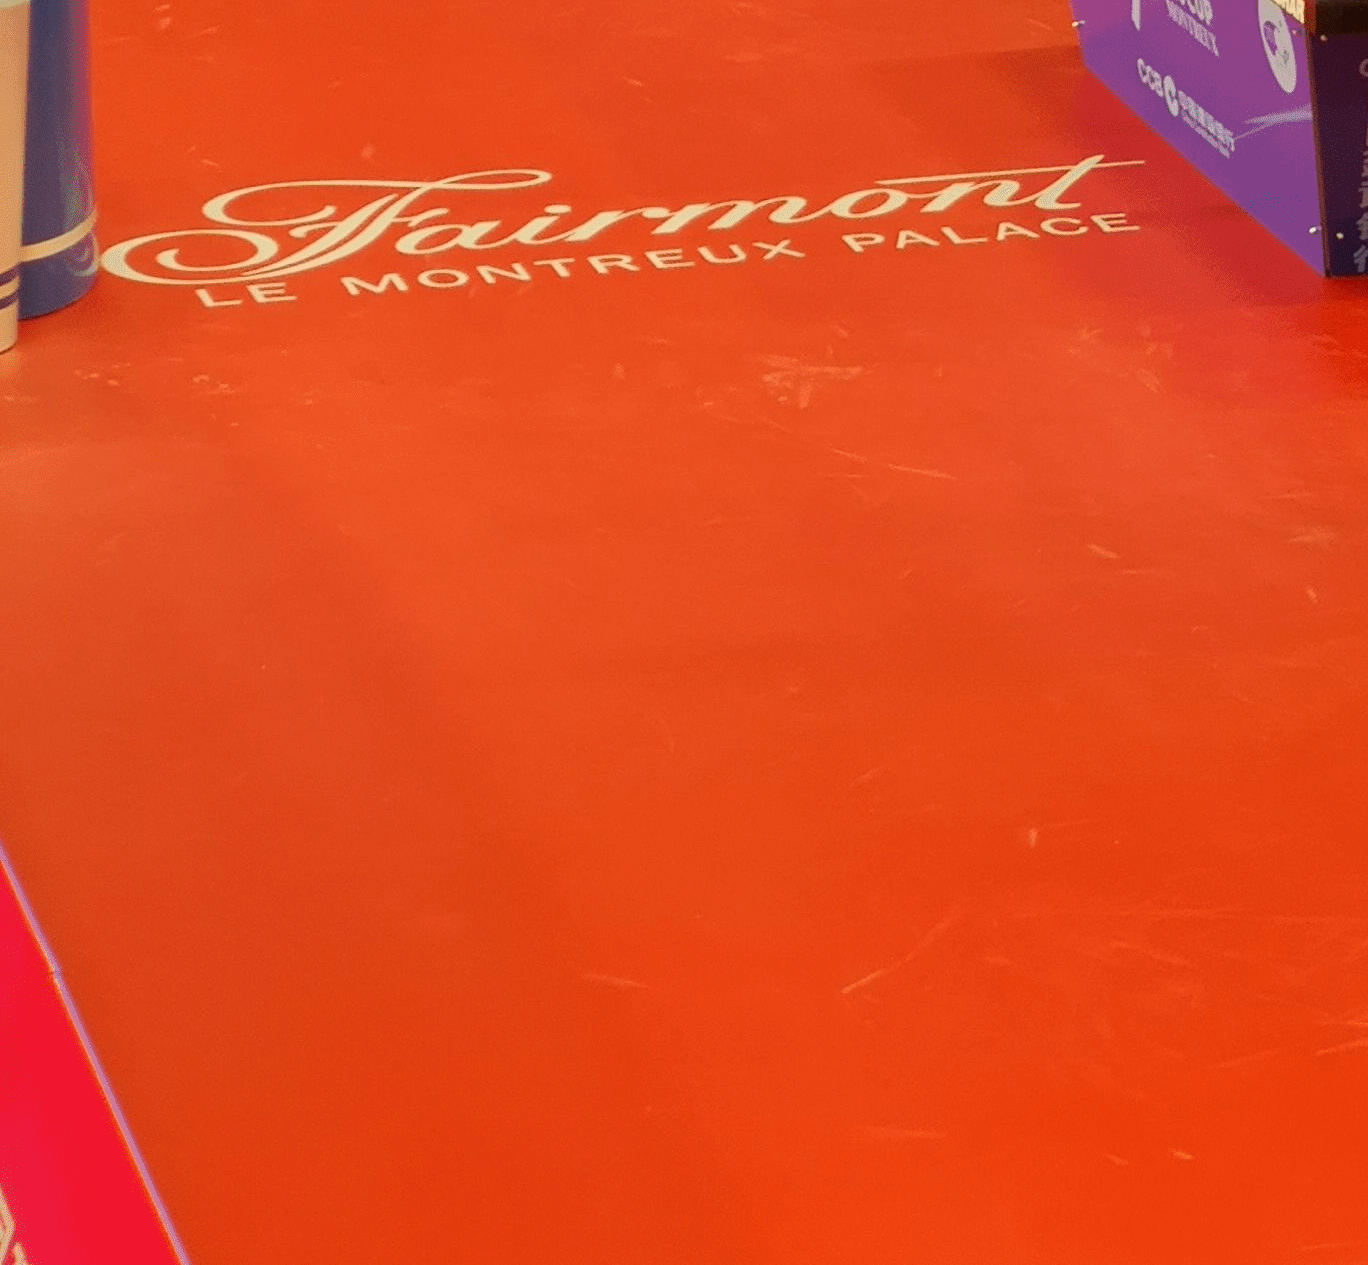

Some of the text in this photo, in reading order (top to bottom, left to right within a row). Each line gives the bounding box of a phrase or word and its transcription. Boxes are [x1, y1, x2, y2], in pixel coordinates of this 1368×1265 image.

[99, 154, 1145, 287] Fairmont
[195, 211, 1139, 308] LE MONTREUX PALACE
